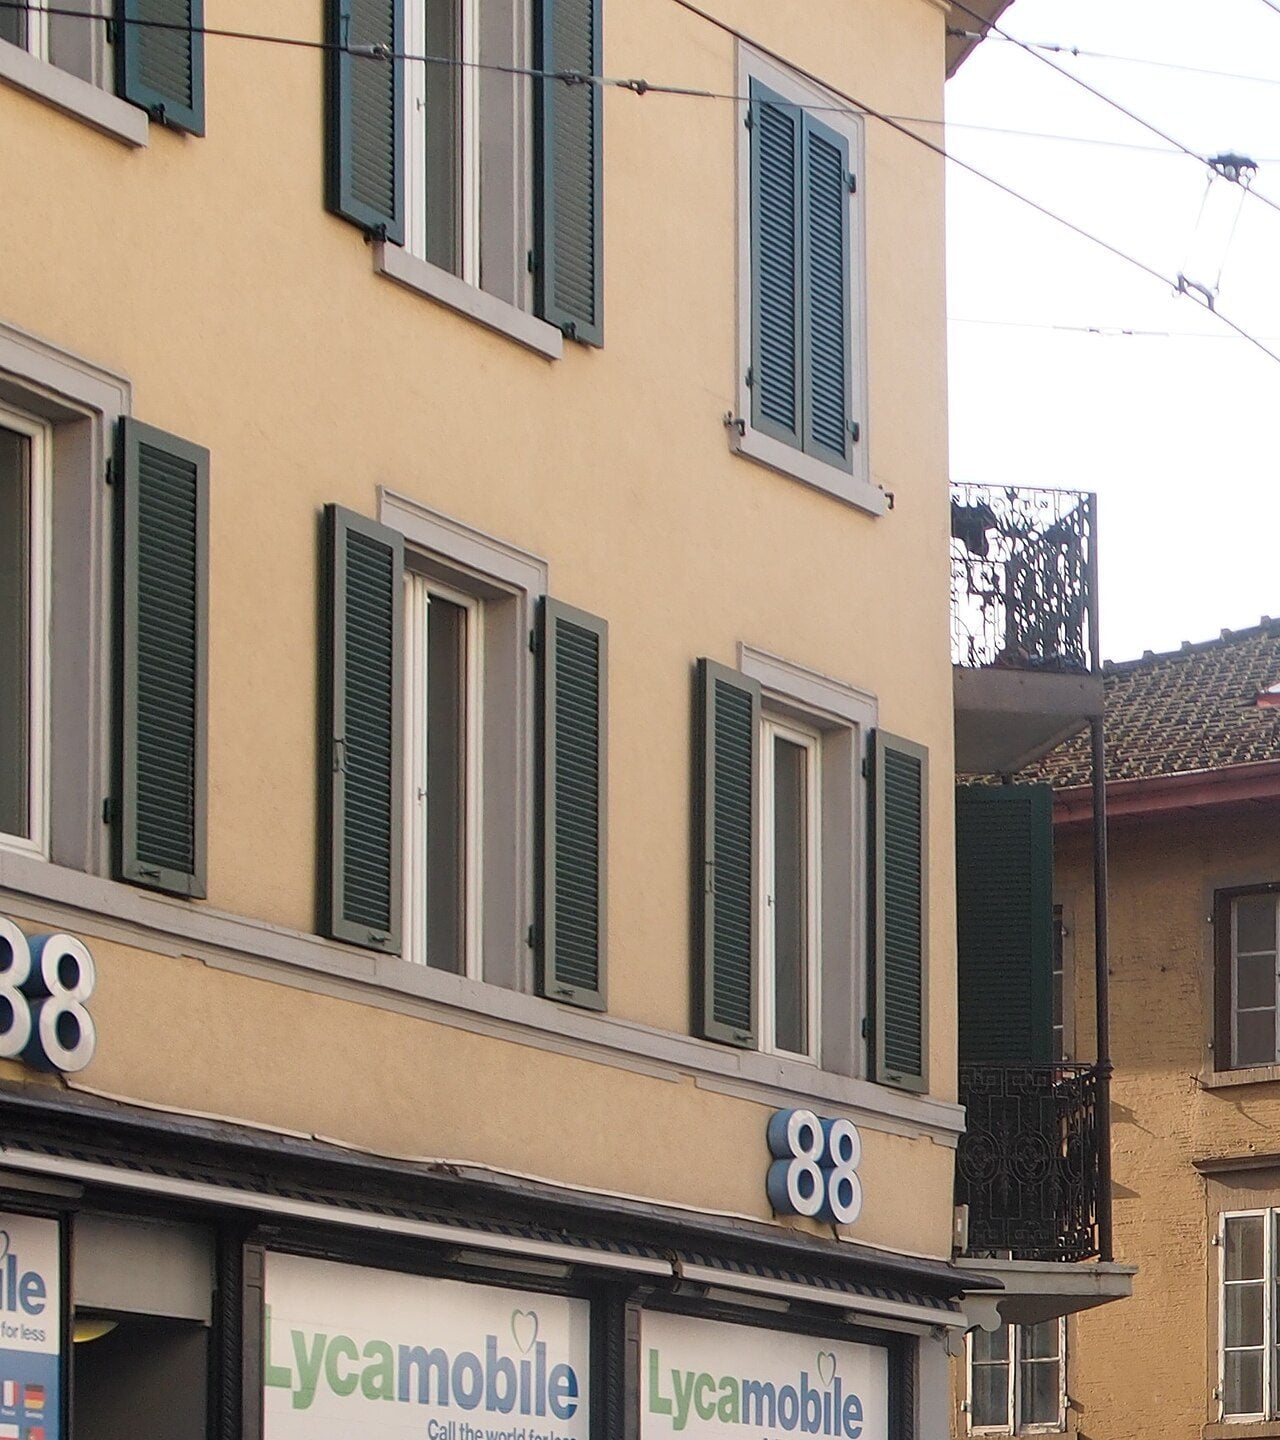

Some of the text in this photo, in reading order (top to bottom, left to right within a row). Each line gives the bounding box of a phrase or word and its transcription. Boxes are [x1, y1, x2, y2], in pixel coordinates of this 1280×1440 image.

[778, 1108, 863, 1226] 88
[1, 1321, 45, 1342] for less
[264, 1303, 579, 1420] Lycamobile
[649, 1349, 864, 1440] Lycamobile
